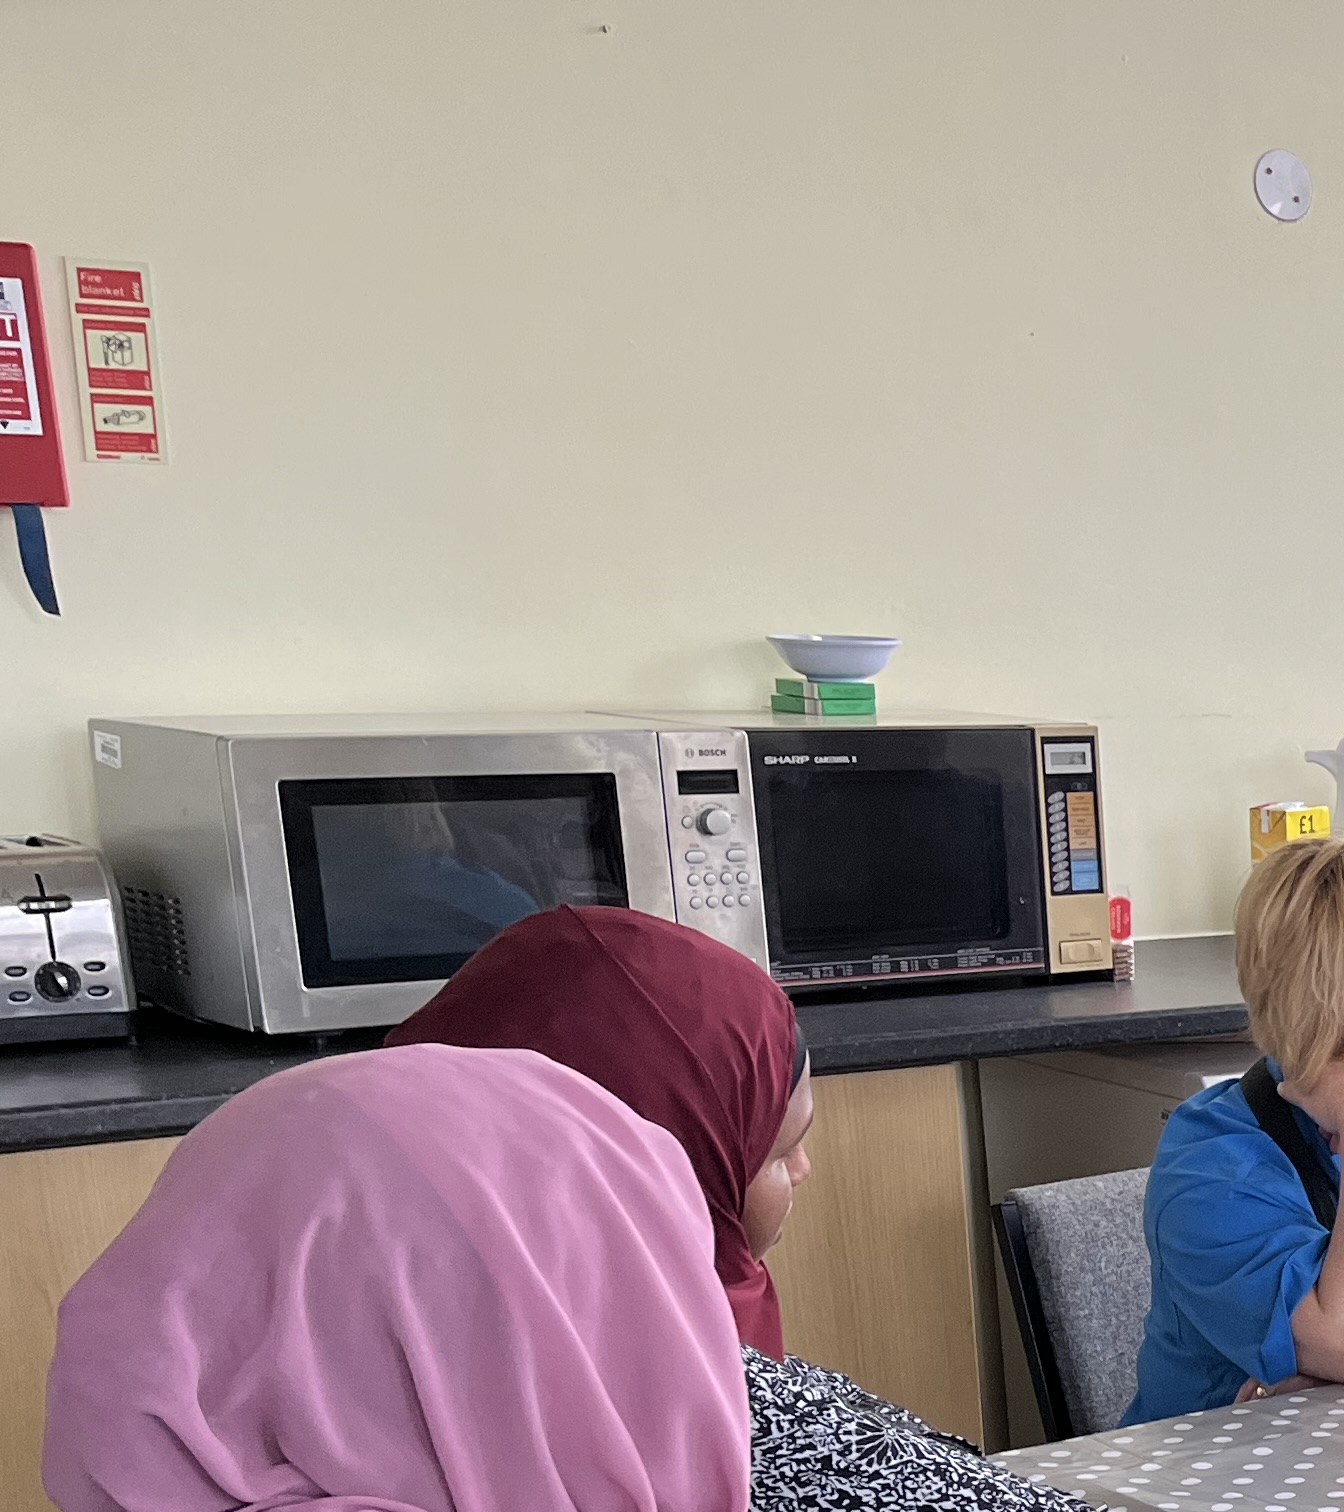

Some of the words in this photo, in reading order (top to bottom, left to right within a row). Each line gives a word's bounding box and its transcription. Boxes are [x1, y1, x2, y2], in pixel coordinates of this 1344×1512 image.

[80, 271, 102, 283] Fire
[81, 284, 125, 297] blanket
[698, 748, 727, 757] BOSCH
[764, 755, 810, 765] SHARP
[1299, 814, 1316, 834] £1
